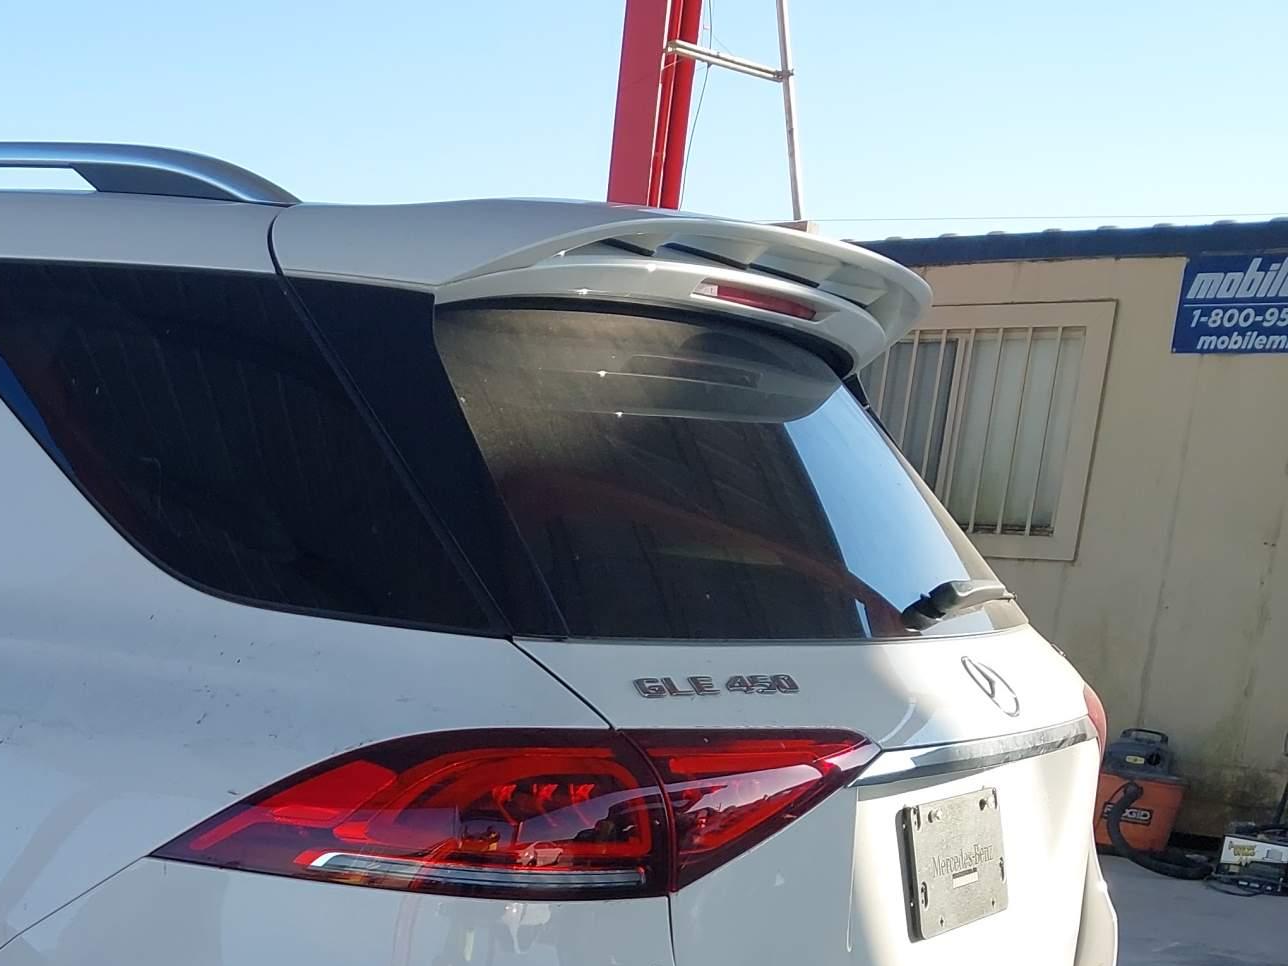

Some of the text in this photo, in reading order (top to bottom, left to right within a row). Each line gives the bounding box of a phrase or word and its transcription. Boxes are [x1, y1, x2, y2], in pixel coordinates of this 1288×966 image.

[633, 673, 800, 698] GLE 450
[931, 842, 994, 879] Mercedes-Benz
